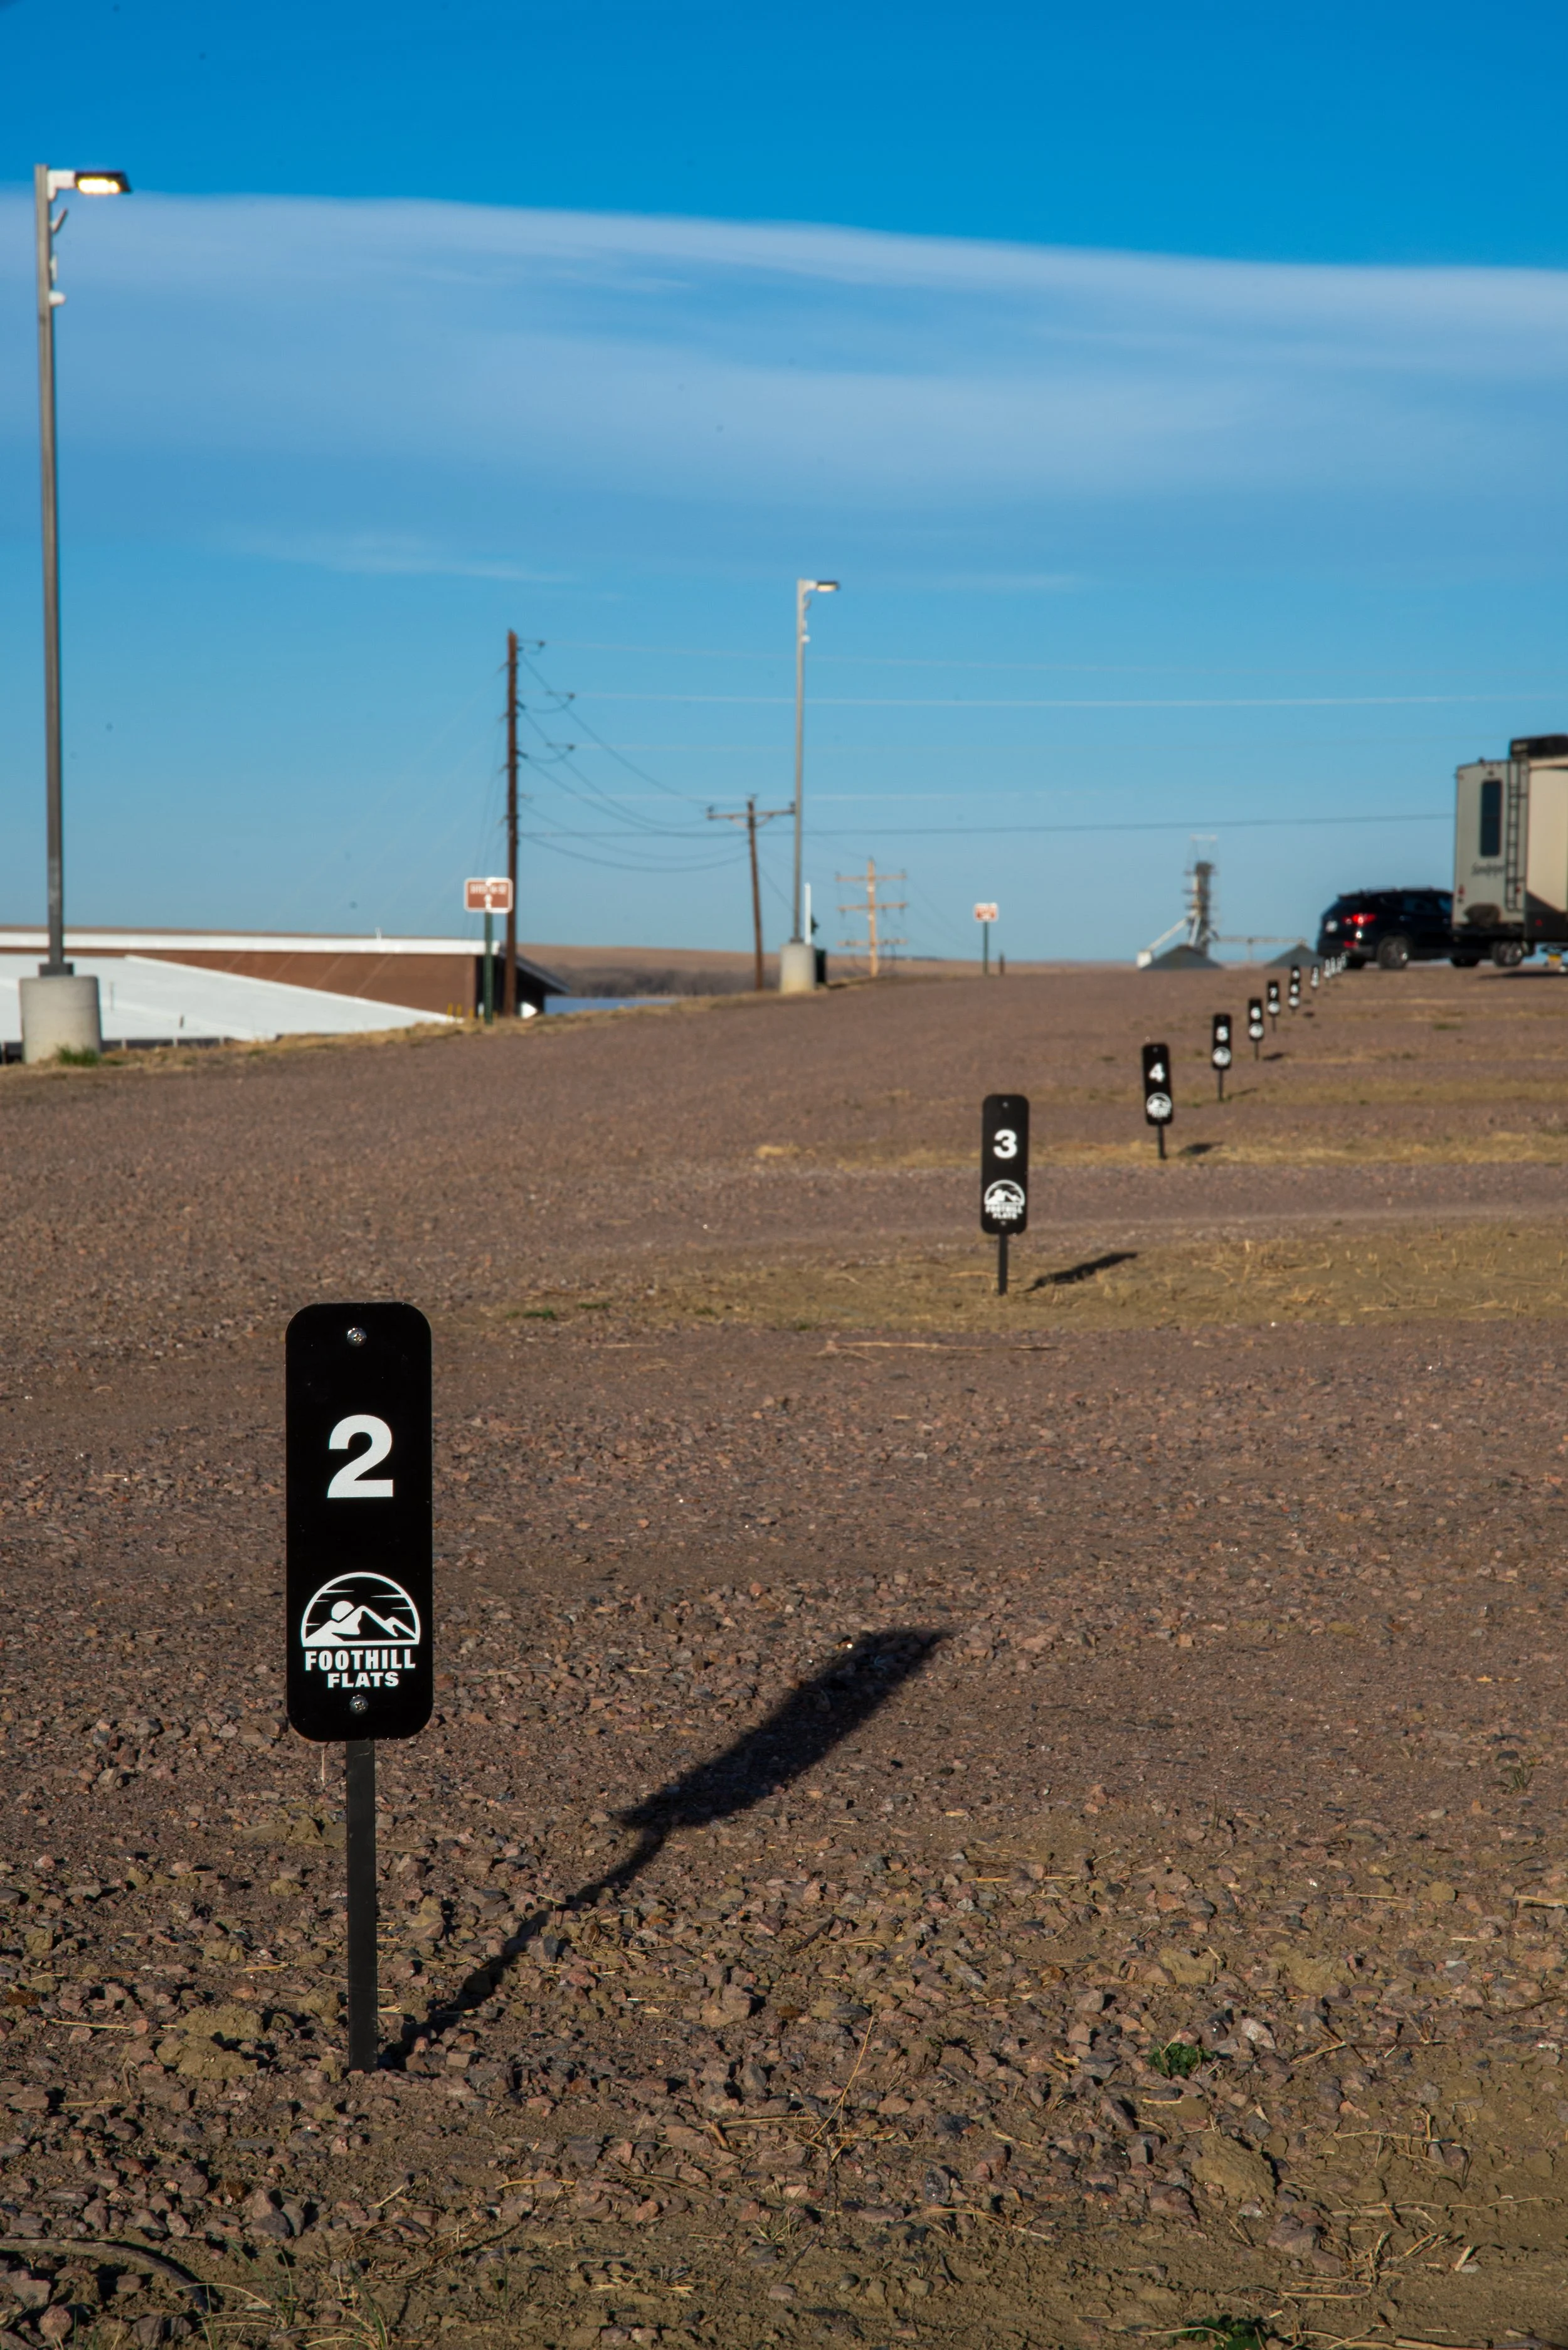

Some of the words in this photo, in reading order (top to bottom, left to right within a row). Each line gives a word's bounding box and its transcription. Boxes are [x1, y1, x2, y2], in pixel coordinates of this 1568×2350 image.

[1149, 1062, 1165, 1082] 4
[993, 1129, 1018, 1159] 3
[327, 1414, 394, 1498] 2
[305, 1649, 416, 1671] FOOTHILL
[327, 1671, 399, 1688] FLATS
